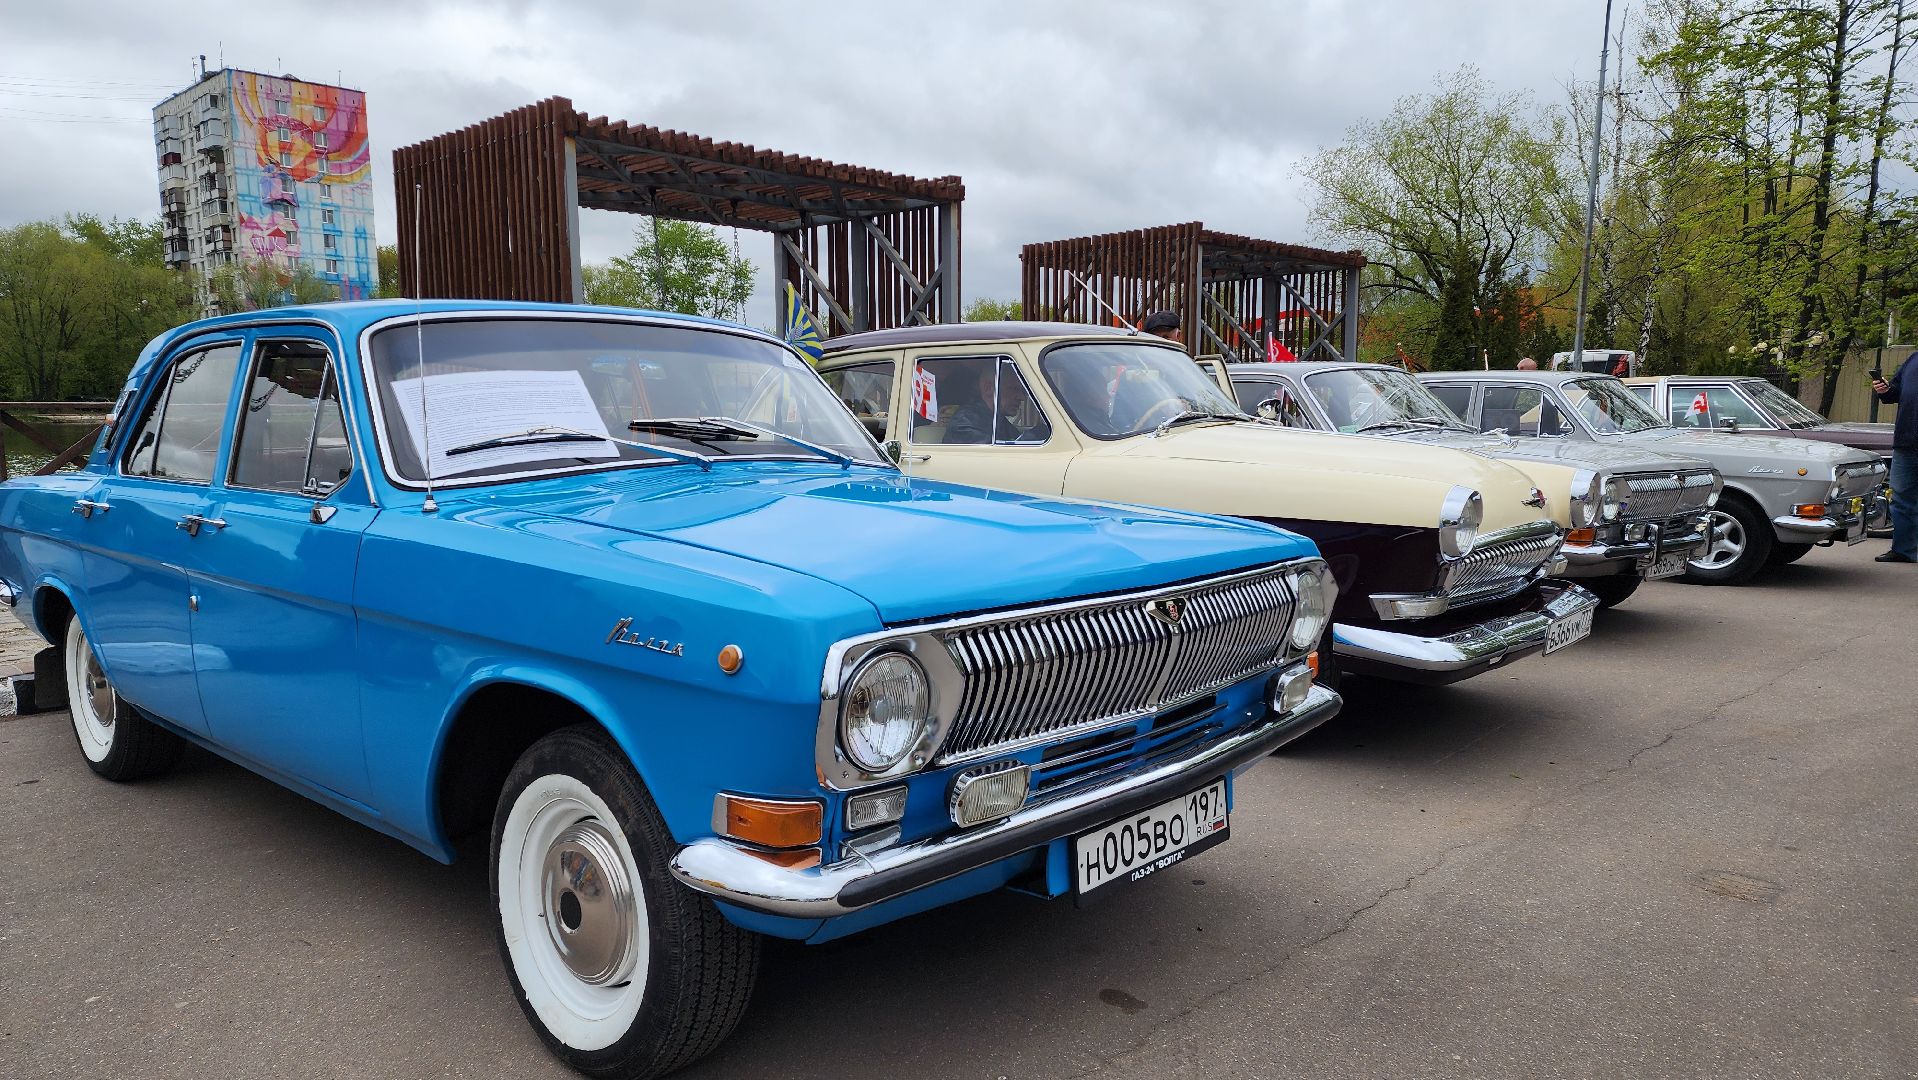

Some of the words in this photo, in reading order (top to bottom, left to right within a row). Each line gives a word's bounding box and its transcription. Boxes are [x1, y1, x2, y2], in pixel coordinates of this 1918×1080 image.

[1086, 814, 1184, 885] Н005ВО
[1189, 786, 1219, 824] 197
[1196, 821, 1213, 837] RUS
